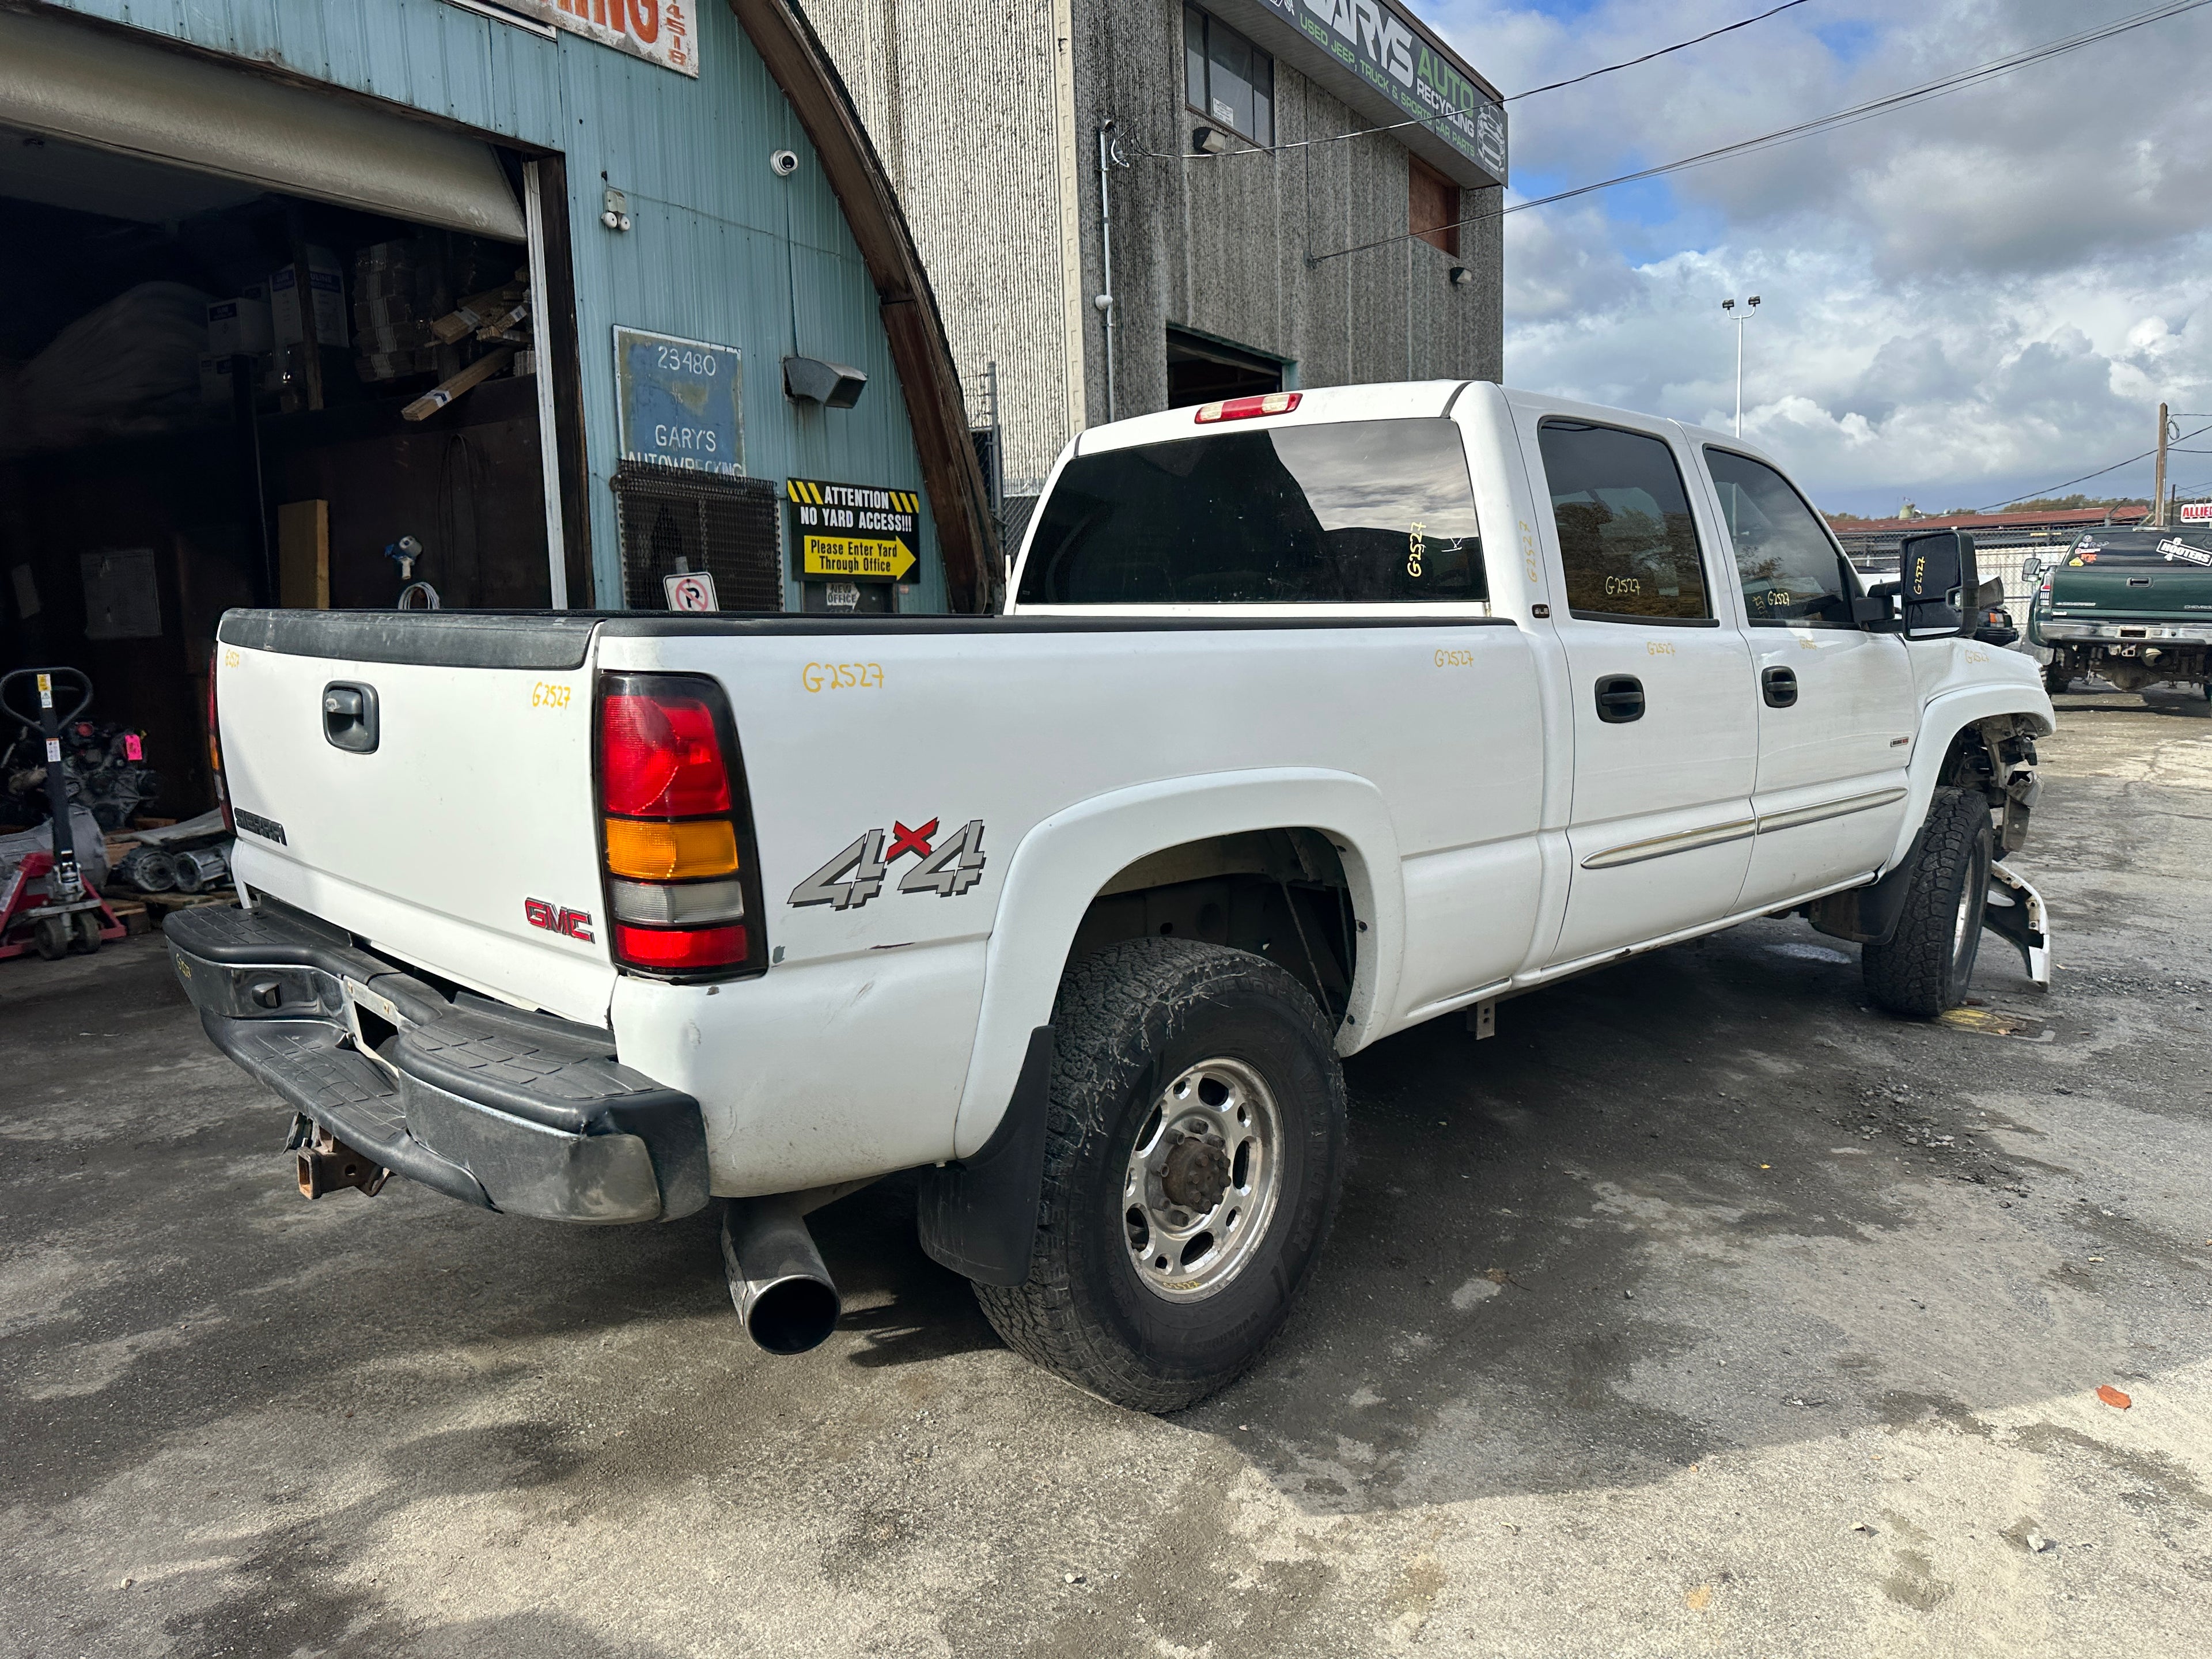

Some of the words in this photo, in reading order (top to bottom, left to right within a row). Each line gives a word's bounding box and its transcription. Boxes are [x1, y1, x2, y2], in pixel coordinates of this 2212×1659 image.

[1300, 12, 1328, 47] USED
[1359, 59, 1389, 93] TRUCK
[1392, 85, 1399, 100] &
[1400, 91, 1433, 125] SPORTS
[1435, 119, 1450, 139] CAR
[1452, 133, 1475, 157] PARTS
[1416, 46, 1474, 119] AUTO
[1416, 77, 1475, 138] RECYCLING
[658, 346, 716, 376] 23480
[655, 424, 716, 452] GARY'S
[824, 486, 889, 510] ATTENTION
[800, 506, 817, 525] NO
[822, 507, 854, 528] YARD
[858, 512, 912, 532] ACCESS!!!
[810, 539, 843, 555] Please
[848, 541, 873, 556] Enter
[877, 543, 897, 557] Yard
[1407, 521, 1426, 577] G2527
[1519, 521, 1537, 582] G2527
[2161, 543, 2210, 563] HOOTERS
[819, 555, 859, 573] Through
[863, 557, 891, 572] Office
[1913, 556, 1926, 595] G2527
[828, 593, 857, 604] OFFICE
[830, 584, 852, 593] NEW
[1605, 576, 1641, 595] G2527
[1767, 590, 1790, 606] G2527
[1434, 649, 1474, 668] G2527
[1647, 641, 1676, 656] G2527
[802, 662, 884, 693] G2527
[532, 681, 571, 710] G2527
[234, 807, 287, 846] SIERRA
[525, 897, 596, 944] GMC
